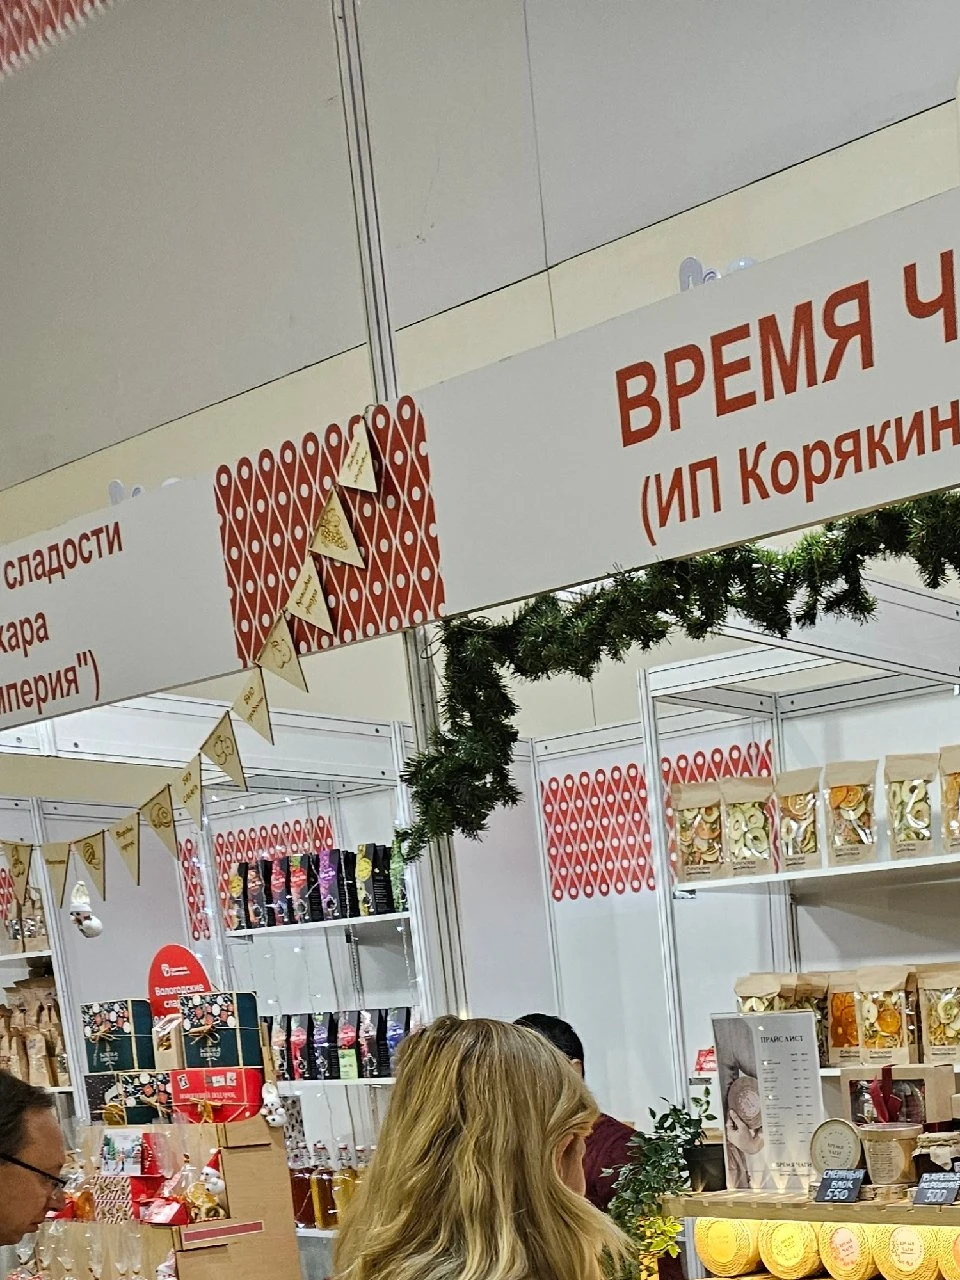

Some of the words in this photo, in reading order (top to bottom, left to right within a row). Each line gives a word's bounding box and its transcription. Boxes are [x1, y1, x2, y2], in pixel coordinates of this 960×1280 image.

[615, 280, 875, 448] ВРЕМЯ
[641, 455, 722, 546] (ИП
[3, 521, 123, 590] сладости
[0, 649, 100, 715] перия")
[824, 1189, 849, 1200] 550
[831, 1180, 853, 1189] БЛОК
[925, 1190, 947, 1201] 500
